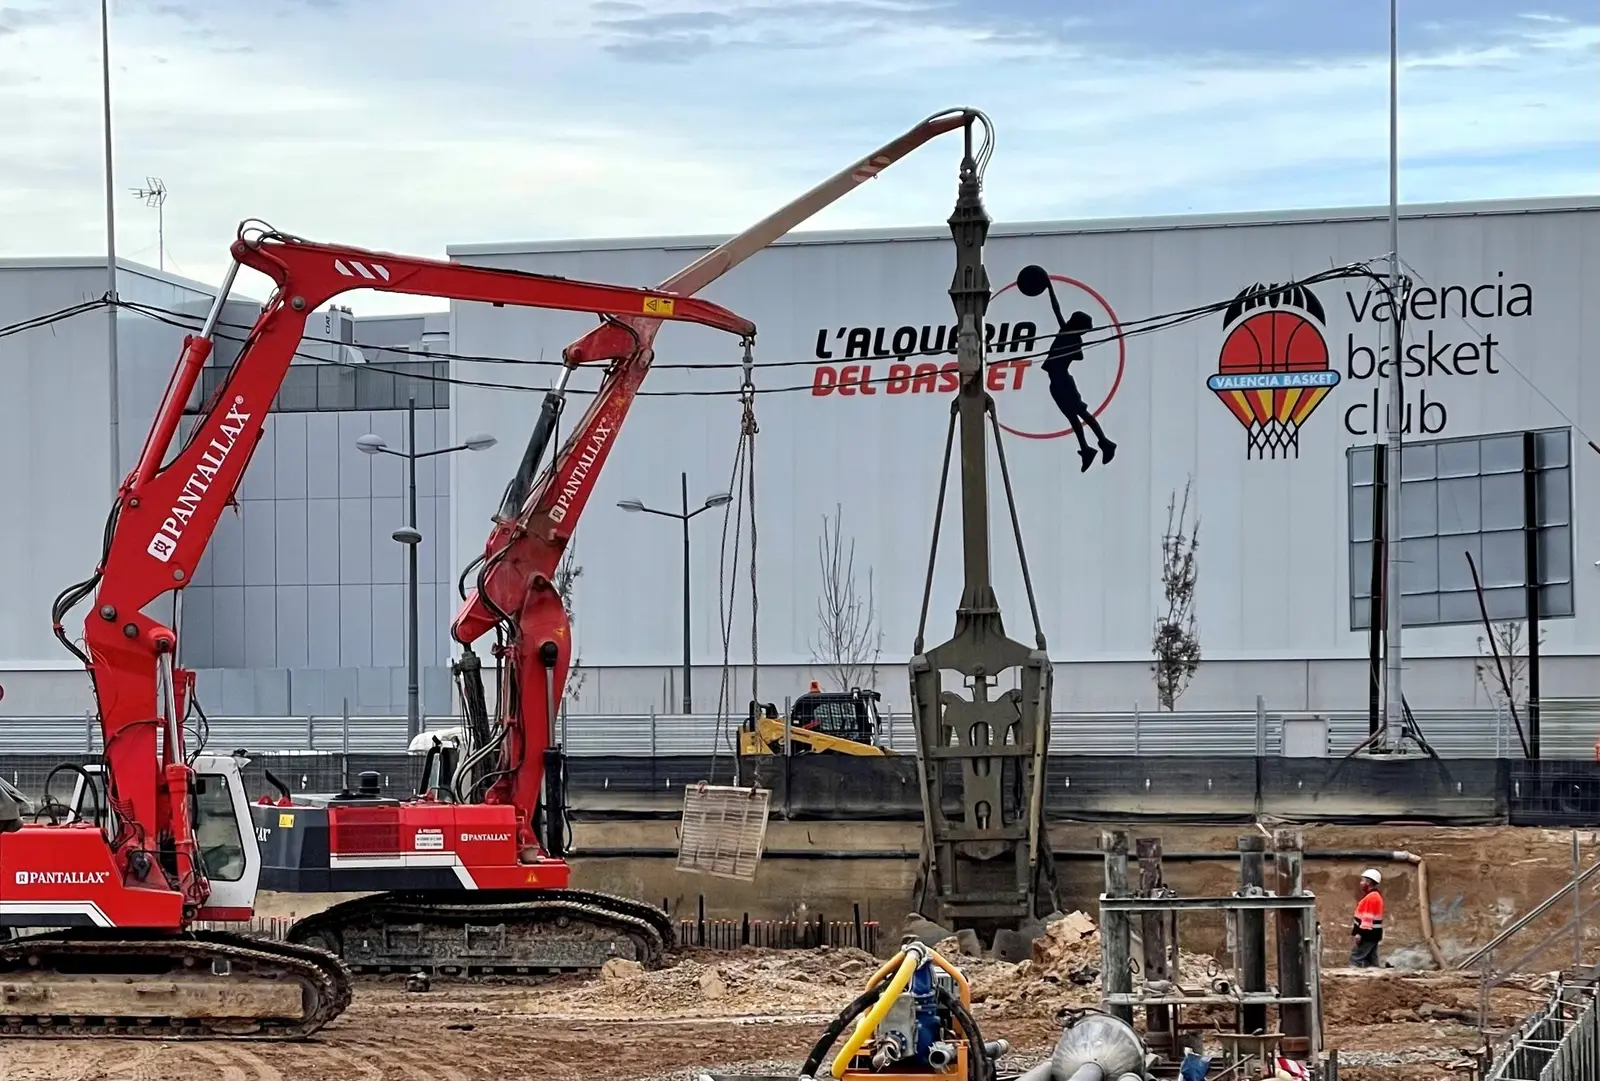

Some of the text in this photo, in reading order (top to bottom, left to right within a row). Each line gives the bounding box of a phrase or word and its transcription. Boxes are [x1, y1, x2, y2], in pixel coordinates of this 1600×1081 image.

[812, 360, 1033, 396] DEL BASET
[1216, 373, 1333, 388] VALENCIA BASKET
